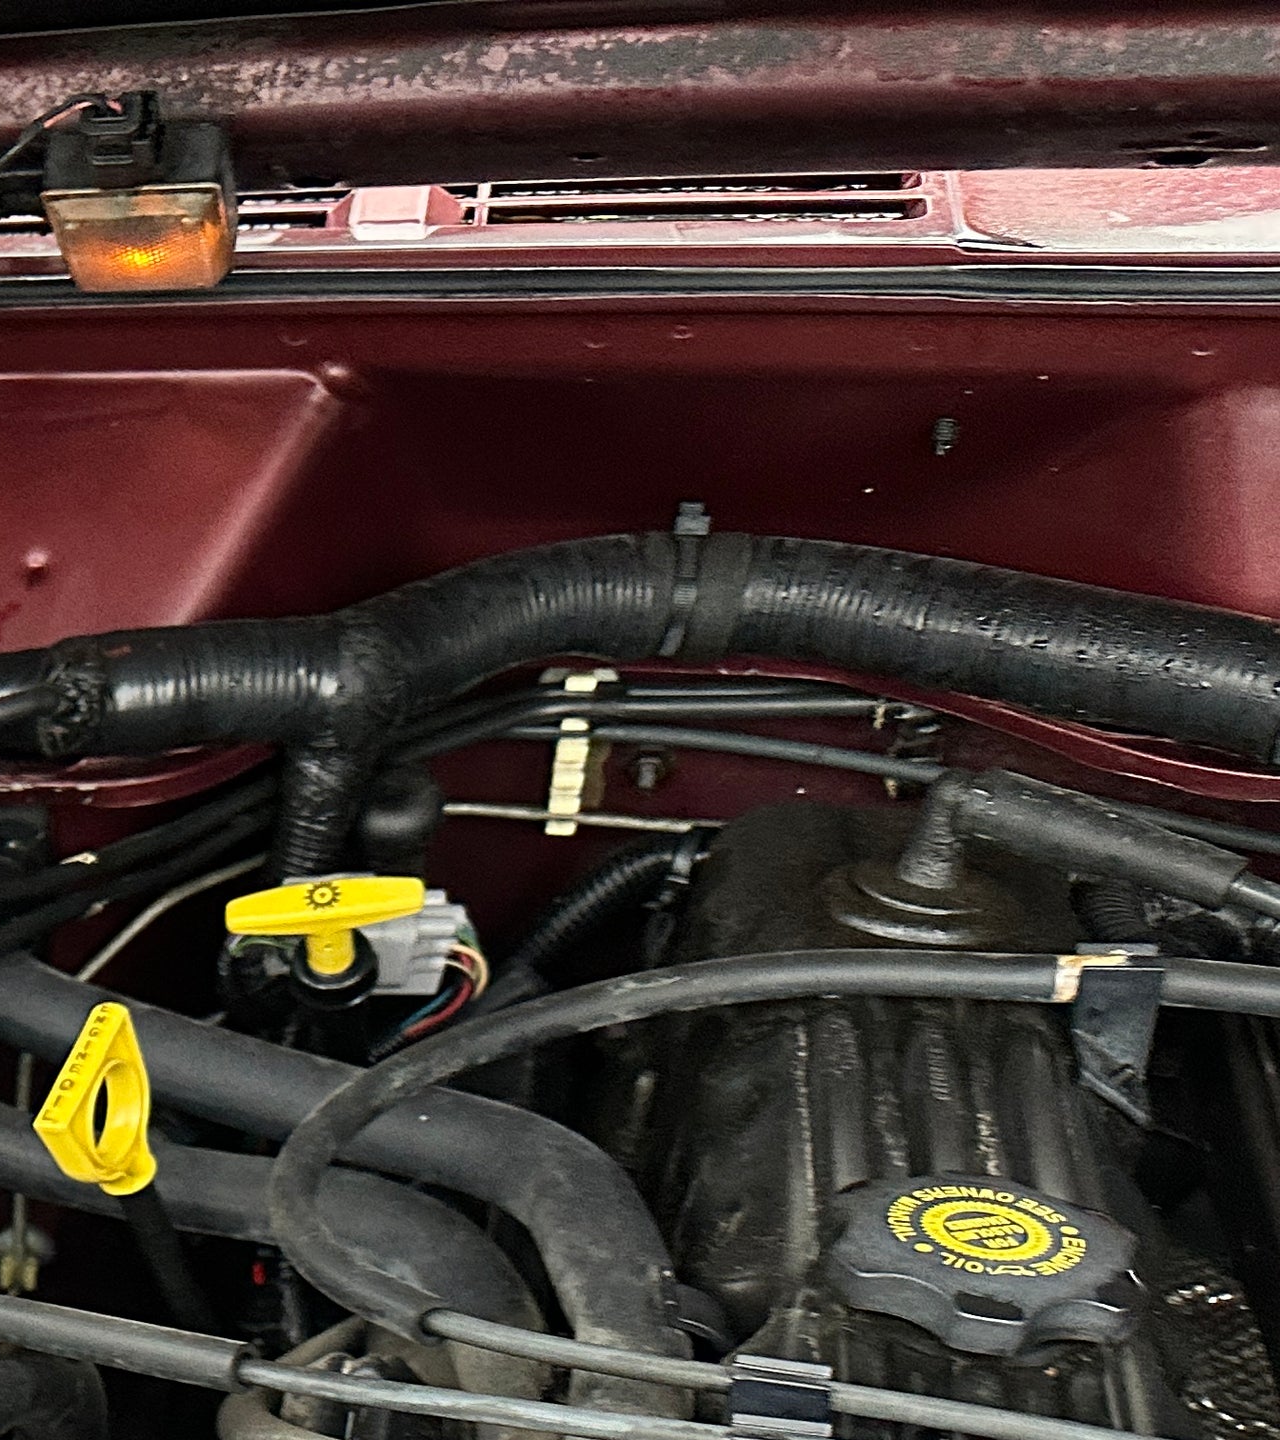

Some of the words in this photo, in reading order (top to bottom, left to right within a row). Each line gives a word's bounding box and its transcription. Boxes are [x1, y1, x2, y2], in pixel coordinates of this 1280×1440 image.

[69, 1005, 111, 1075] ENGINE
[42, 1078, 75, 1123] OIL
[912, 1186, 1013, 1202] OWNERS
[1014, 1197, 1066, 1224] SEE
[885, 1195, 921, 1241] MANUAL
[983, 1235, 1017, 1248] FOR
[1031, 1236, 1085, 1275] ENGINE
[940, 1252, 984, 1273] OIL
